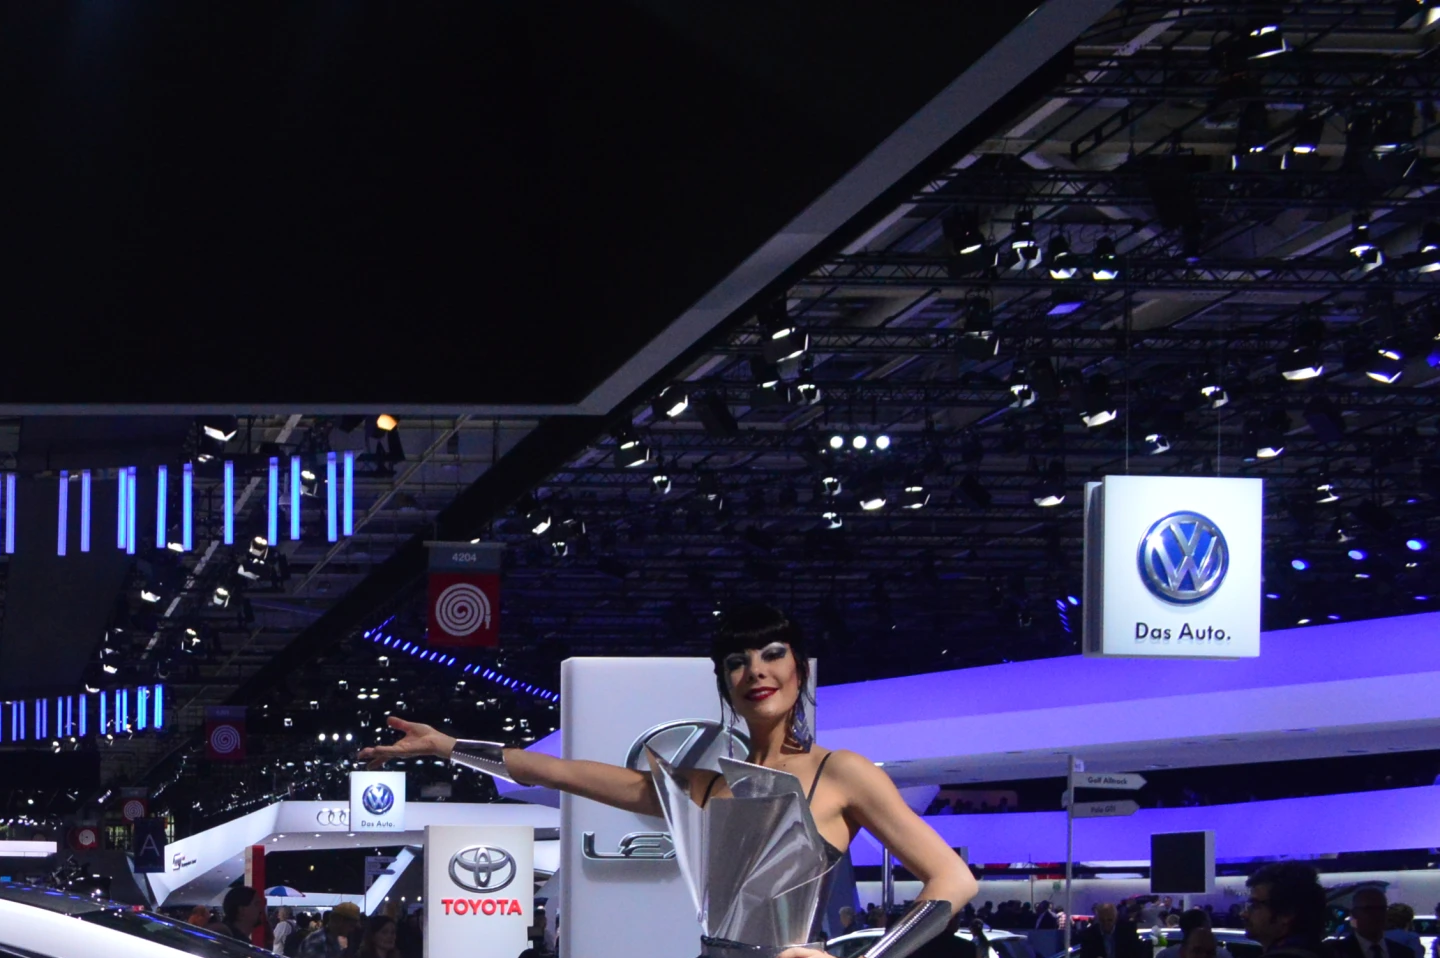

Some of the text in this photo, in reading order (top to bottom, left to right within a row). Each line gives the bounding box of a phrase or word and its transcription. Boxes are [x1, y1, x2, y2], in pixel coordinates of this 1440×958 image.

[1135, 622, 1231, 640] Das Auto.
[441, 898, 522, 916] TOYOTA
